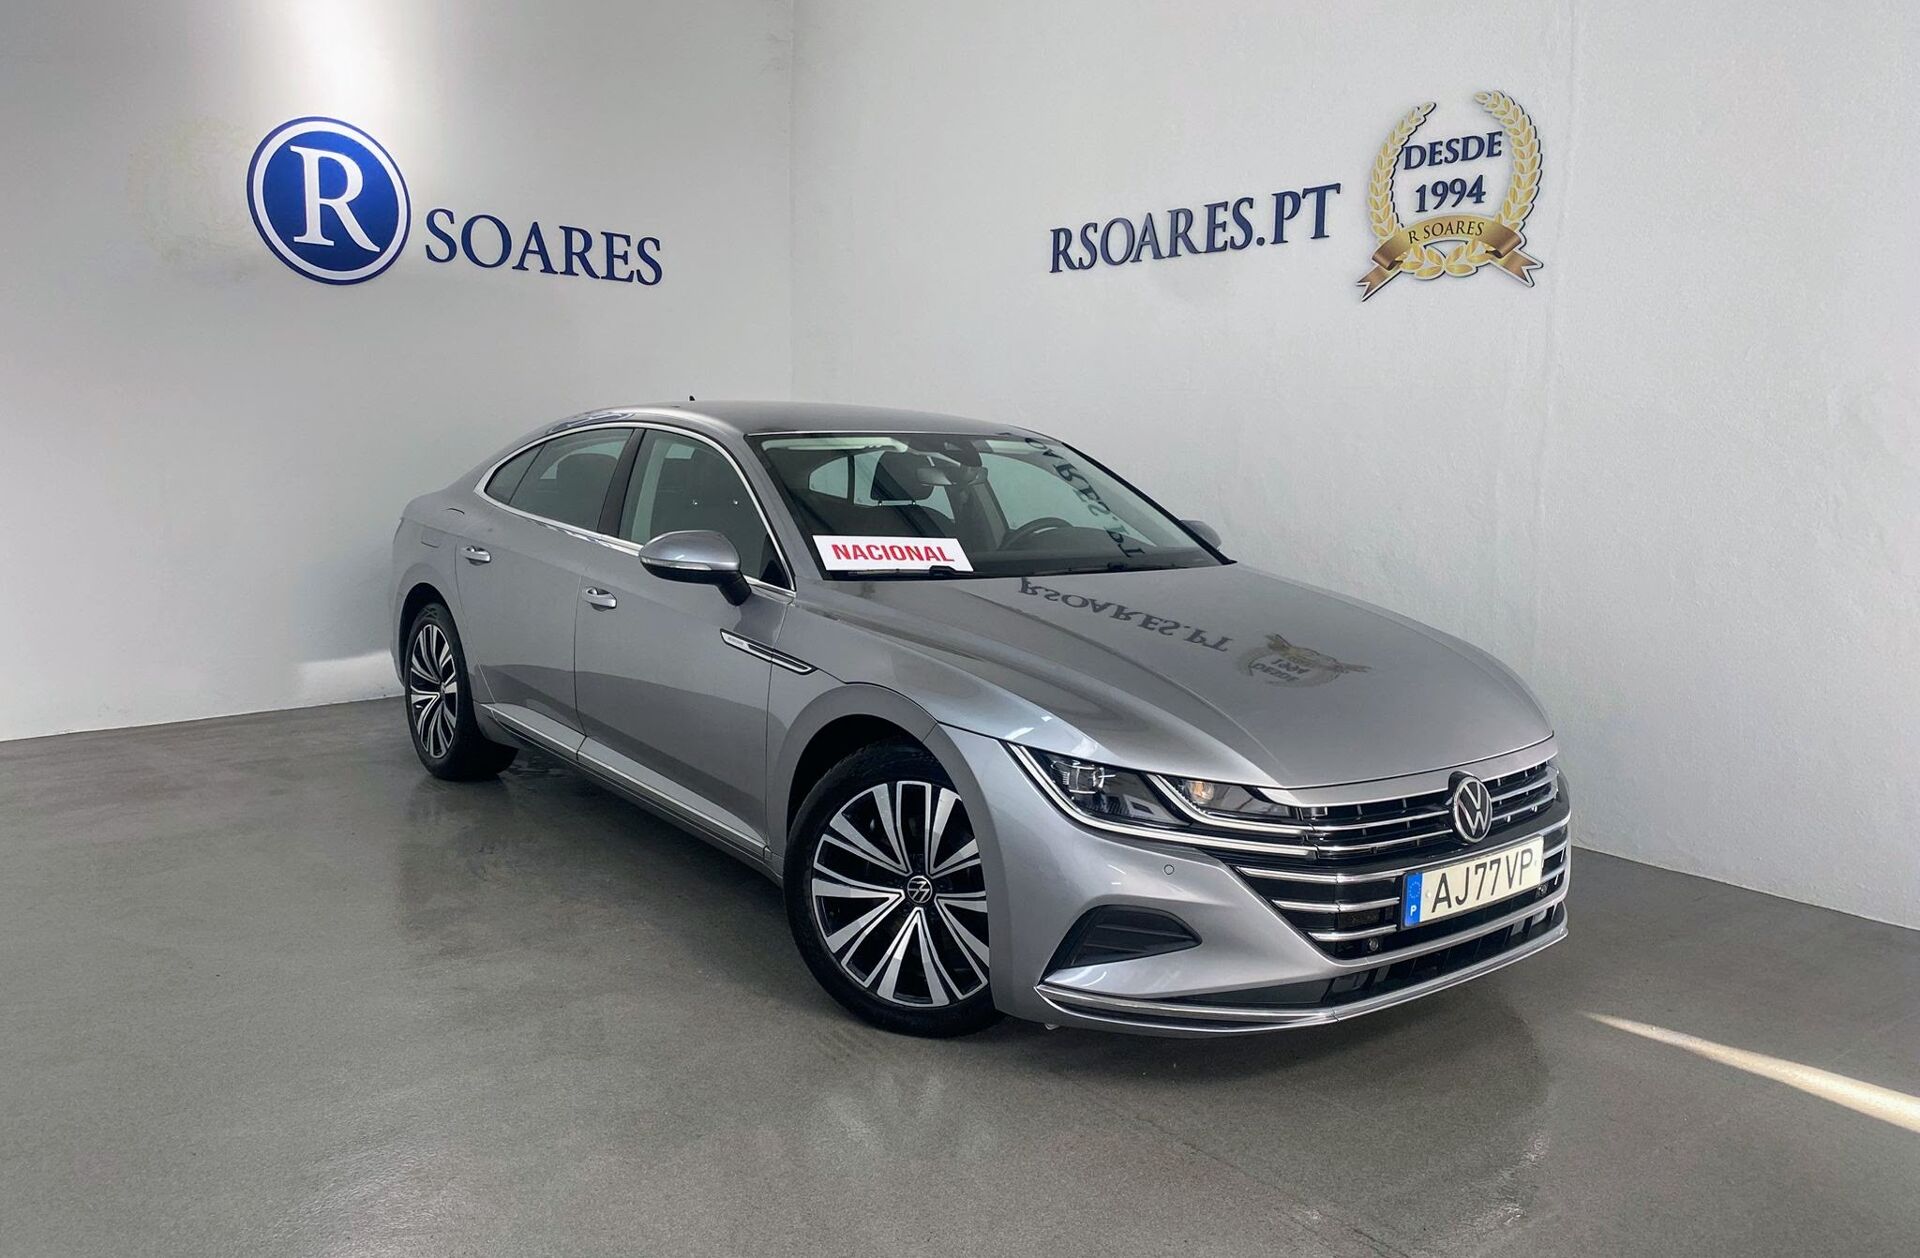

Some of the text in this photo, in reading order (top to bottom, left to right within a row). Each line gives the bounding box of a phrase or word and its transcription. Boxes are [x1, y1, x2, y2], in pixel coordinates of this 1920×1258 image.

[1403, 131, 1503, 170] DESDE
[1415, 175, 1486, 213] 1994
[290, 145, 663, 286] R SOARES
[1050, 183, 1341, 273] RSOARES.PT
[1408, 221, 1485, 244] R SOARES
[831, 543, 955, 562] NACIONAL
[1431, 848, 1533, 913] AJ77VP
[1410, 905, 1418, 917] P
